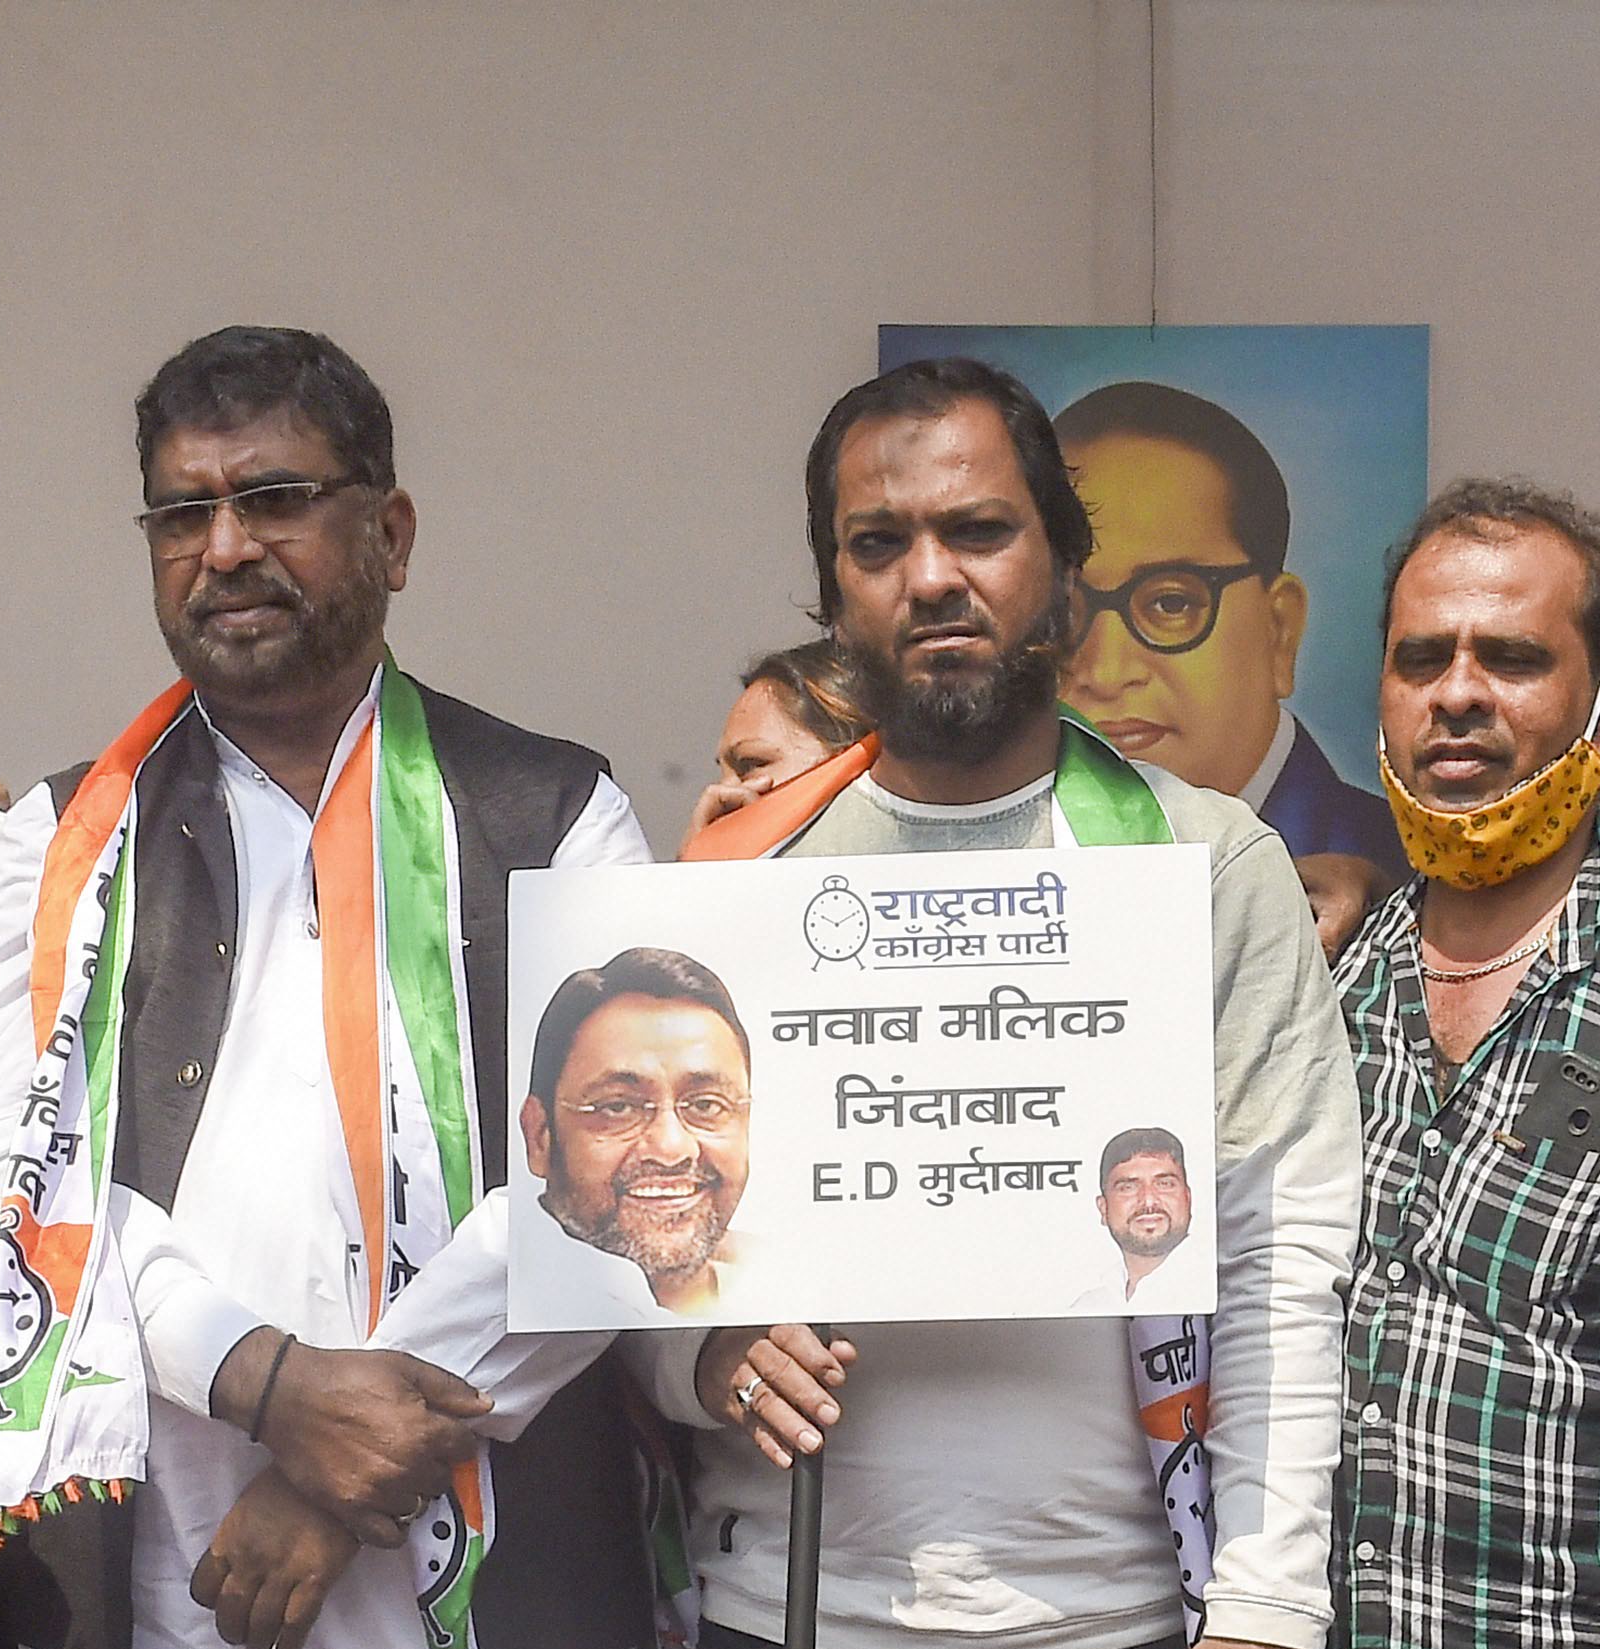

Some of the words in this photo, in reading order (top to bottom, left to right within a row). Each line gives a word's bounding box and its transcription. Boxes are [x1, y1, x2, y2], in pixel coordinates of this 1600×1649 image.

[997, 920, 1069, 954] पार्टी
[771, 1006, 922, 1046] नवाब
[939, 985, 1128, 1040] मलिक
[835, 1074, 1065, 1129] जिंदाबाद
[813, 1162, 897, 1202] E.D
[918, 1147, 1082, 1206] मुर्दाबाद
